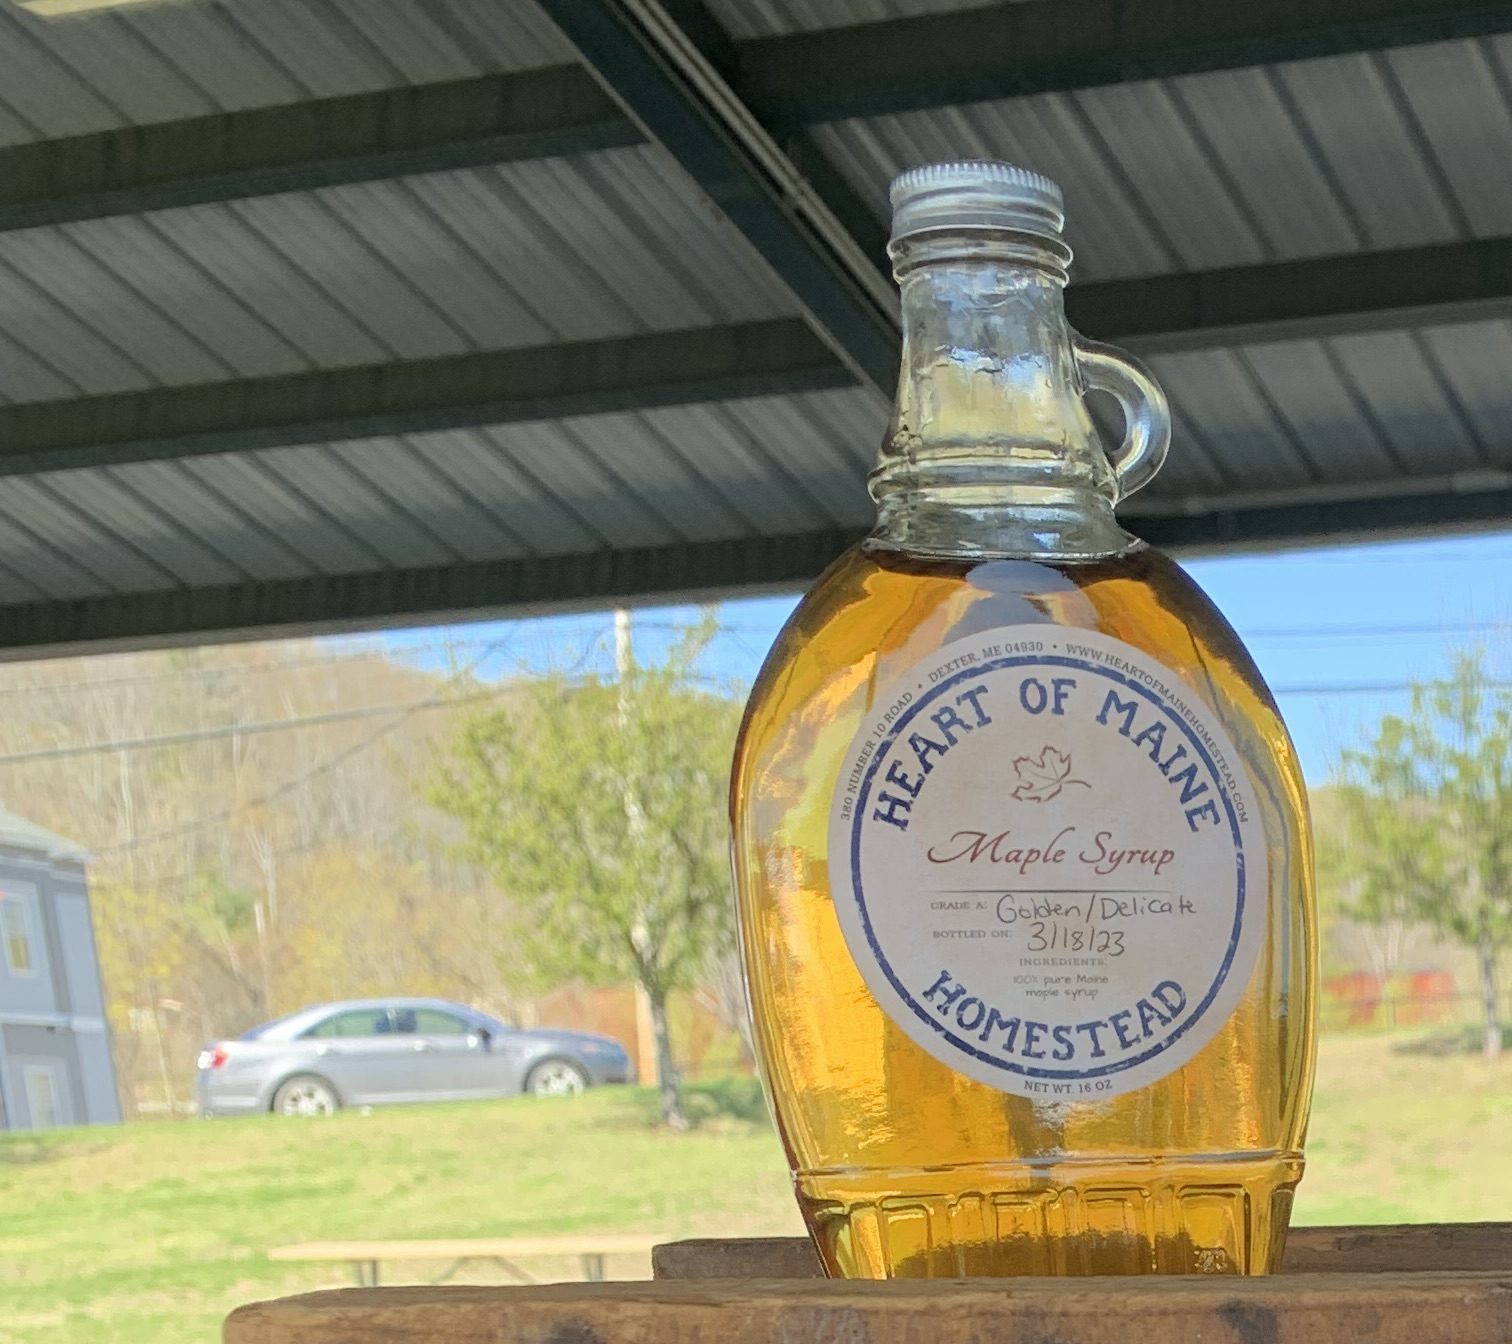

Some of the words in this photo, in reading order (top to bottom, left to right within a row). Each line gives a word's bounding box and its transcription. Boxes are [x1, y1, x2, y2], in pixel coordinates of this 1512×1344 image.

[847, 740, 876, 795] NUMBER
[873, 723, 886, 739] 10
[885, 692, 912, 724] ROAD
[982, 646, 1002, 658] ME
[1005, 642, 1043, 653] 04930
[1066, 644, 1247, 823] WWW.HEARTOFMAINEHOMESTEAD.COM
[873, 685, 992, 831] HEART
[1020, 677, 1077, 714] OF
[1096, 690, 1220, 832] MAINE
[928, 826, 1075, 875] Maple
[1079, 831, 1174, 875] Syrup
[922, 970, 1186, 1061] HOMESTEAD
[1024, 1080, 1049, 1092] NET
[1079, 1083, 1091, 1093] 16
[1095, 1080, 1113, 1092] OZ
